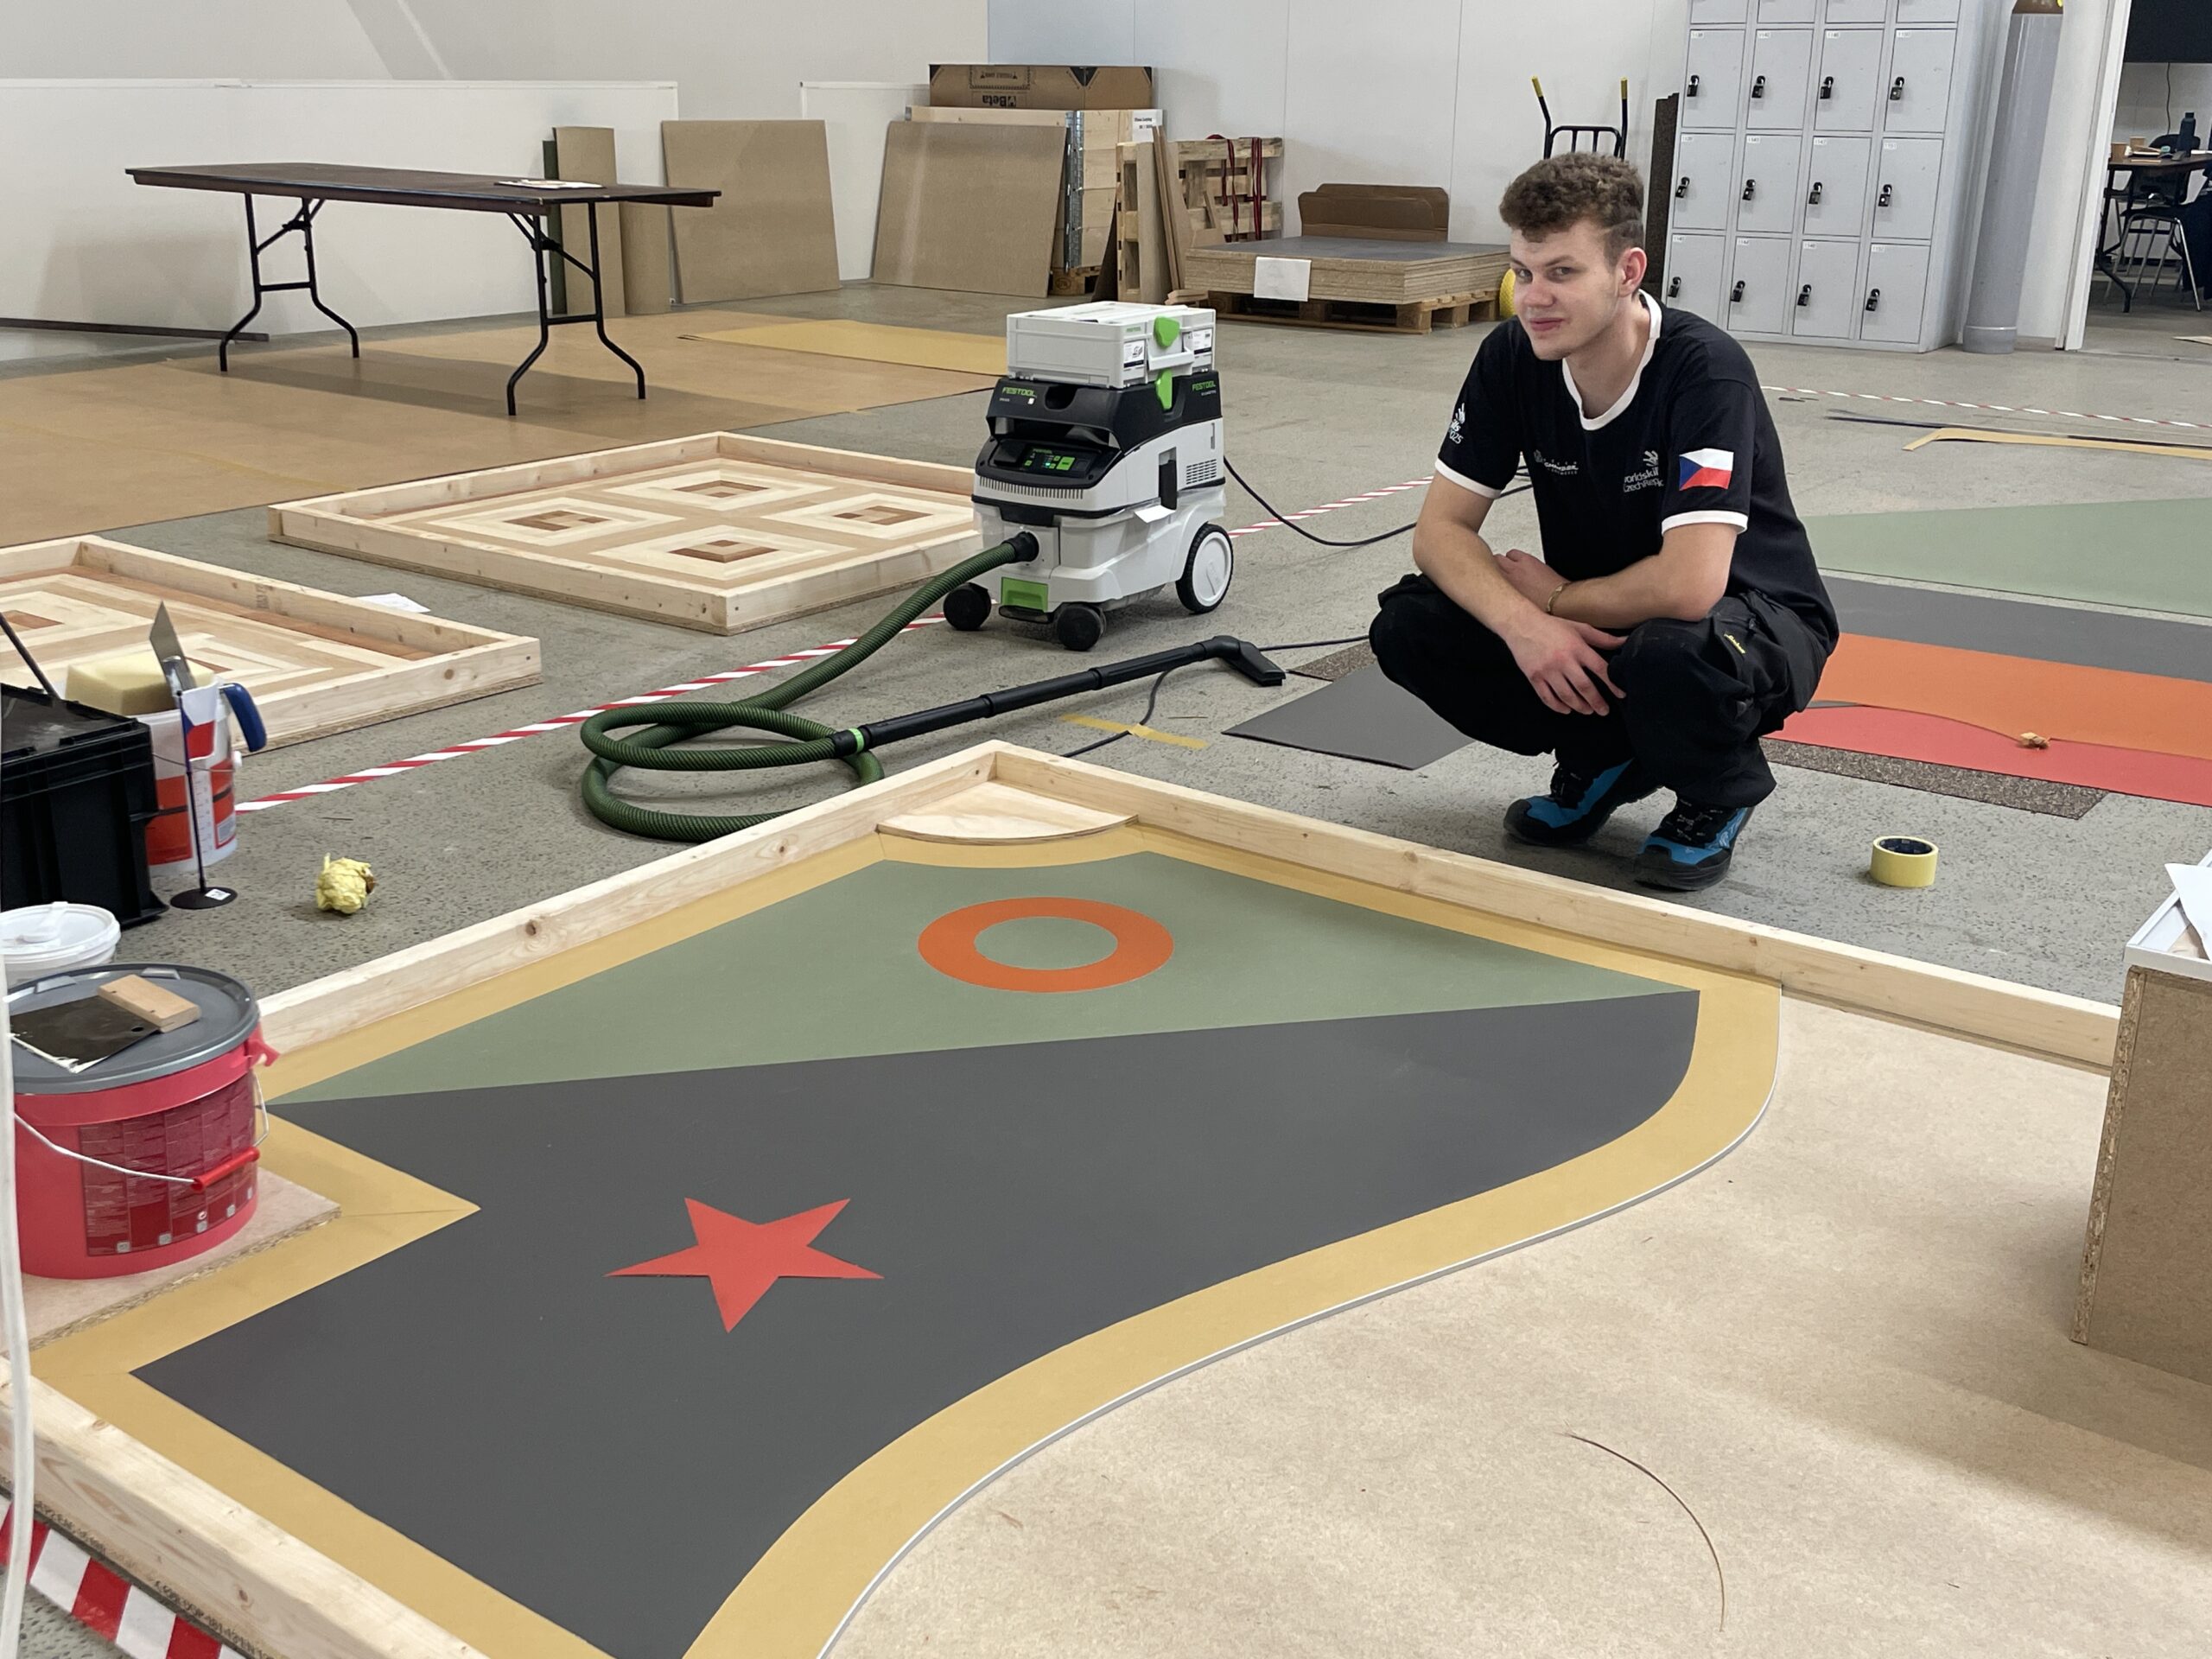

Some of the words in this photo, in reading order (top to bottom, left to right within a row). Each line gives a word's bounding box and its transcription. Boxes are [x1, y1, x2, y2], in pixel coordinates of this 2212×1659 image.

[982, 95, 1007, 107] Beta
[1192, 380, 1217, 391] FESTOOL
[1002, 386, 1037, 397] FESTOOL
[1449, 429, 1464, 444] 025
